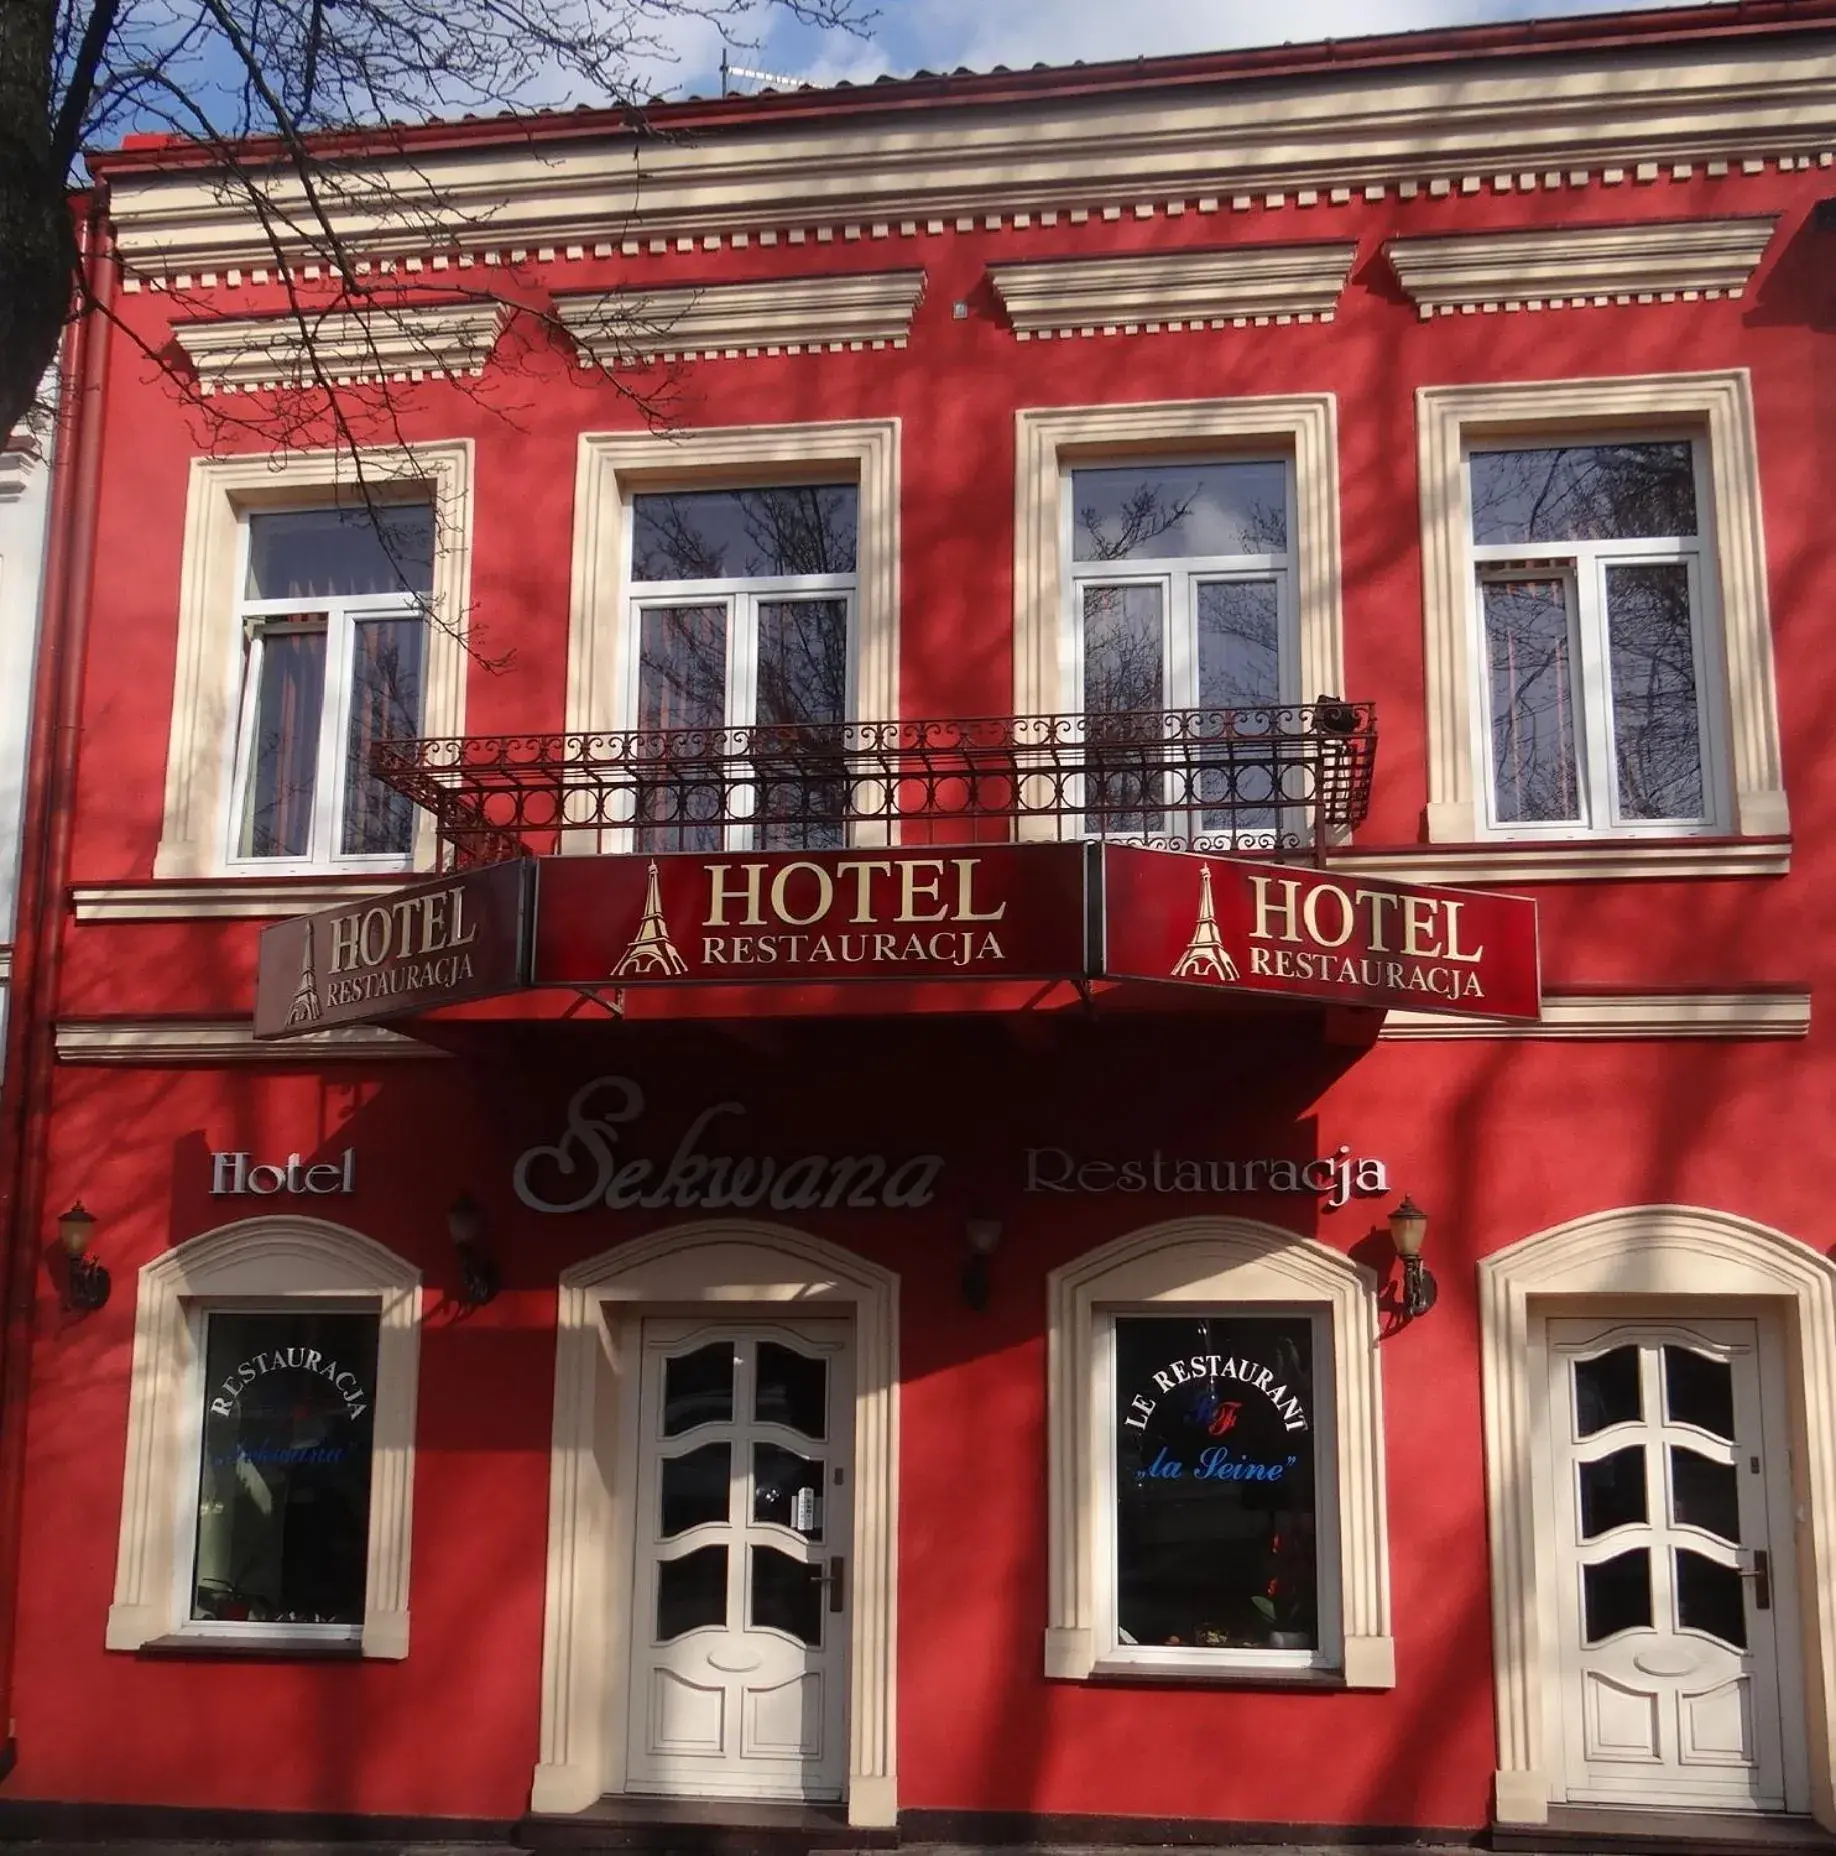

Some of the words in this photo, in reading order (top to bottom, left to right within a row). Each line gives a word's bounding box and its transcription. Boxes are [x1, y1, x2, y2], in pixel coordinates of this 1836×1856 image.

[701, 858, 1008, 927] HOTEL
[1248, 875, 1483, 963] HOTEL
[328, 886, 477, 975] HOTEL
[701, 931, 1006, 967] RESTAURACJA
[326, 953, 475, 1008] RESTAURACJA
[1249, 947, 1486, 1001] RESTAURACJA
[209, 1147, 355, 1196] Hotel
[512, 1075, 945, 1213] Sekwana
[1023, 1145, 1391, 1207] Restauracja
[210, 1347, 368, 1422] RESTAURACJA
[1124, 1394, 1157, 1432] LE
[1152, 1355, 1309, 1433] RESTAURANT
